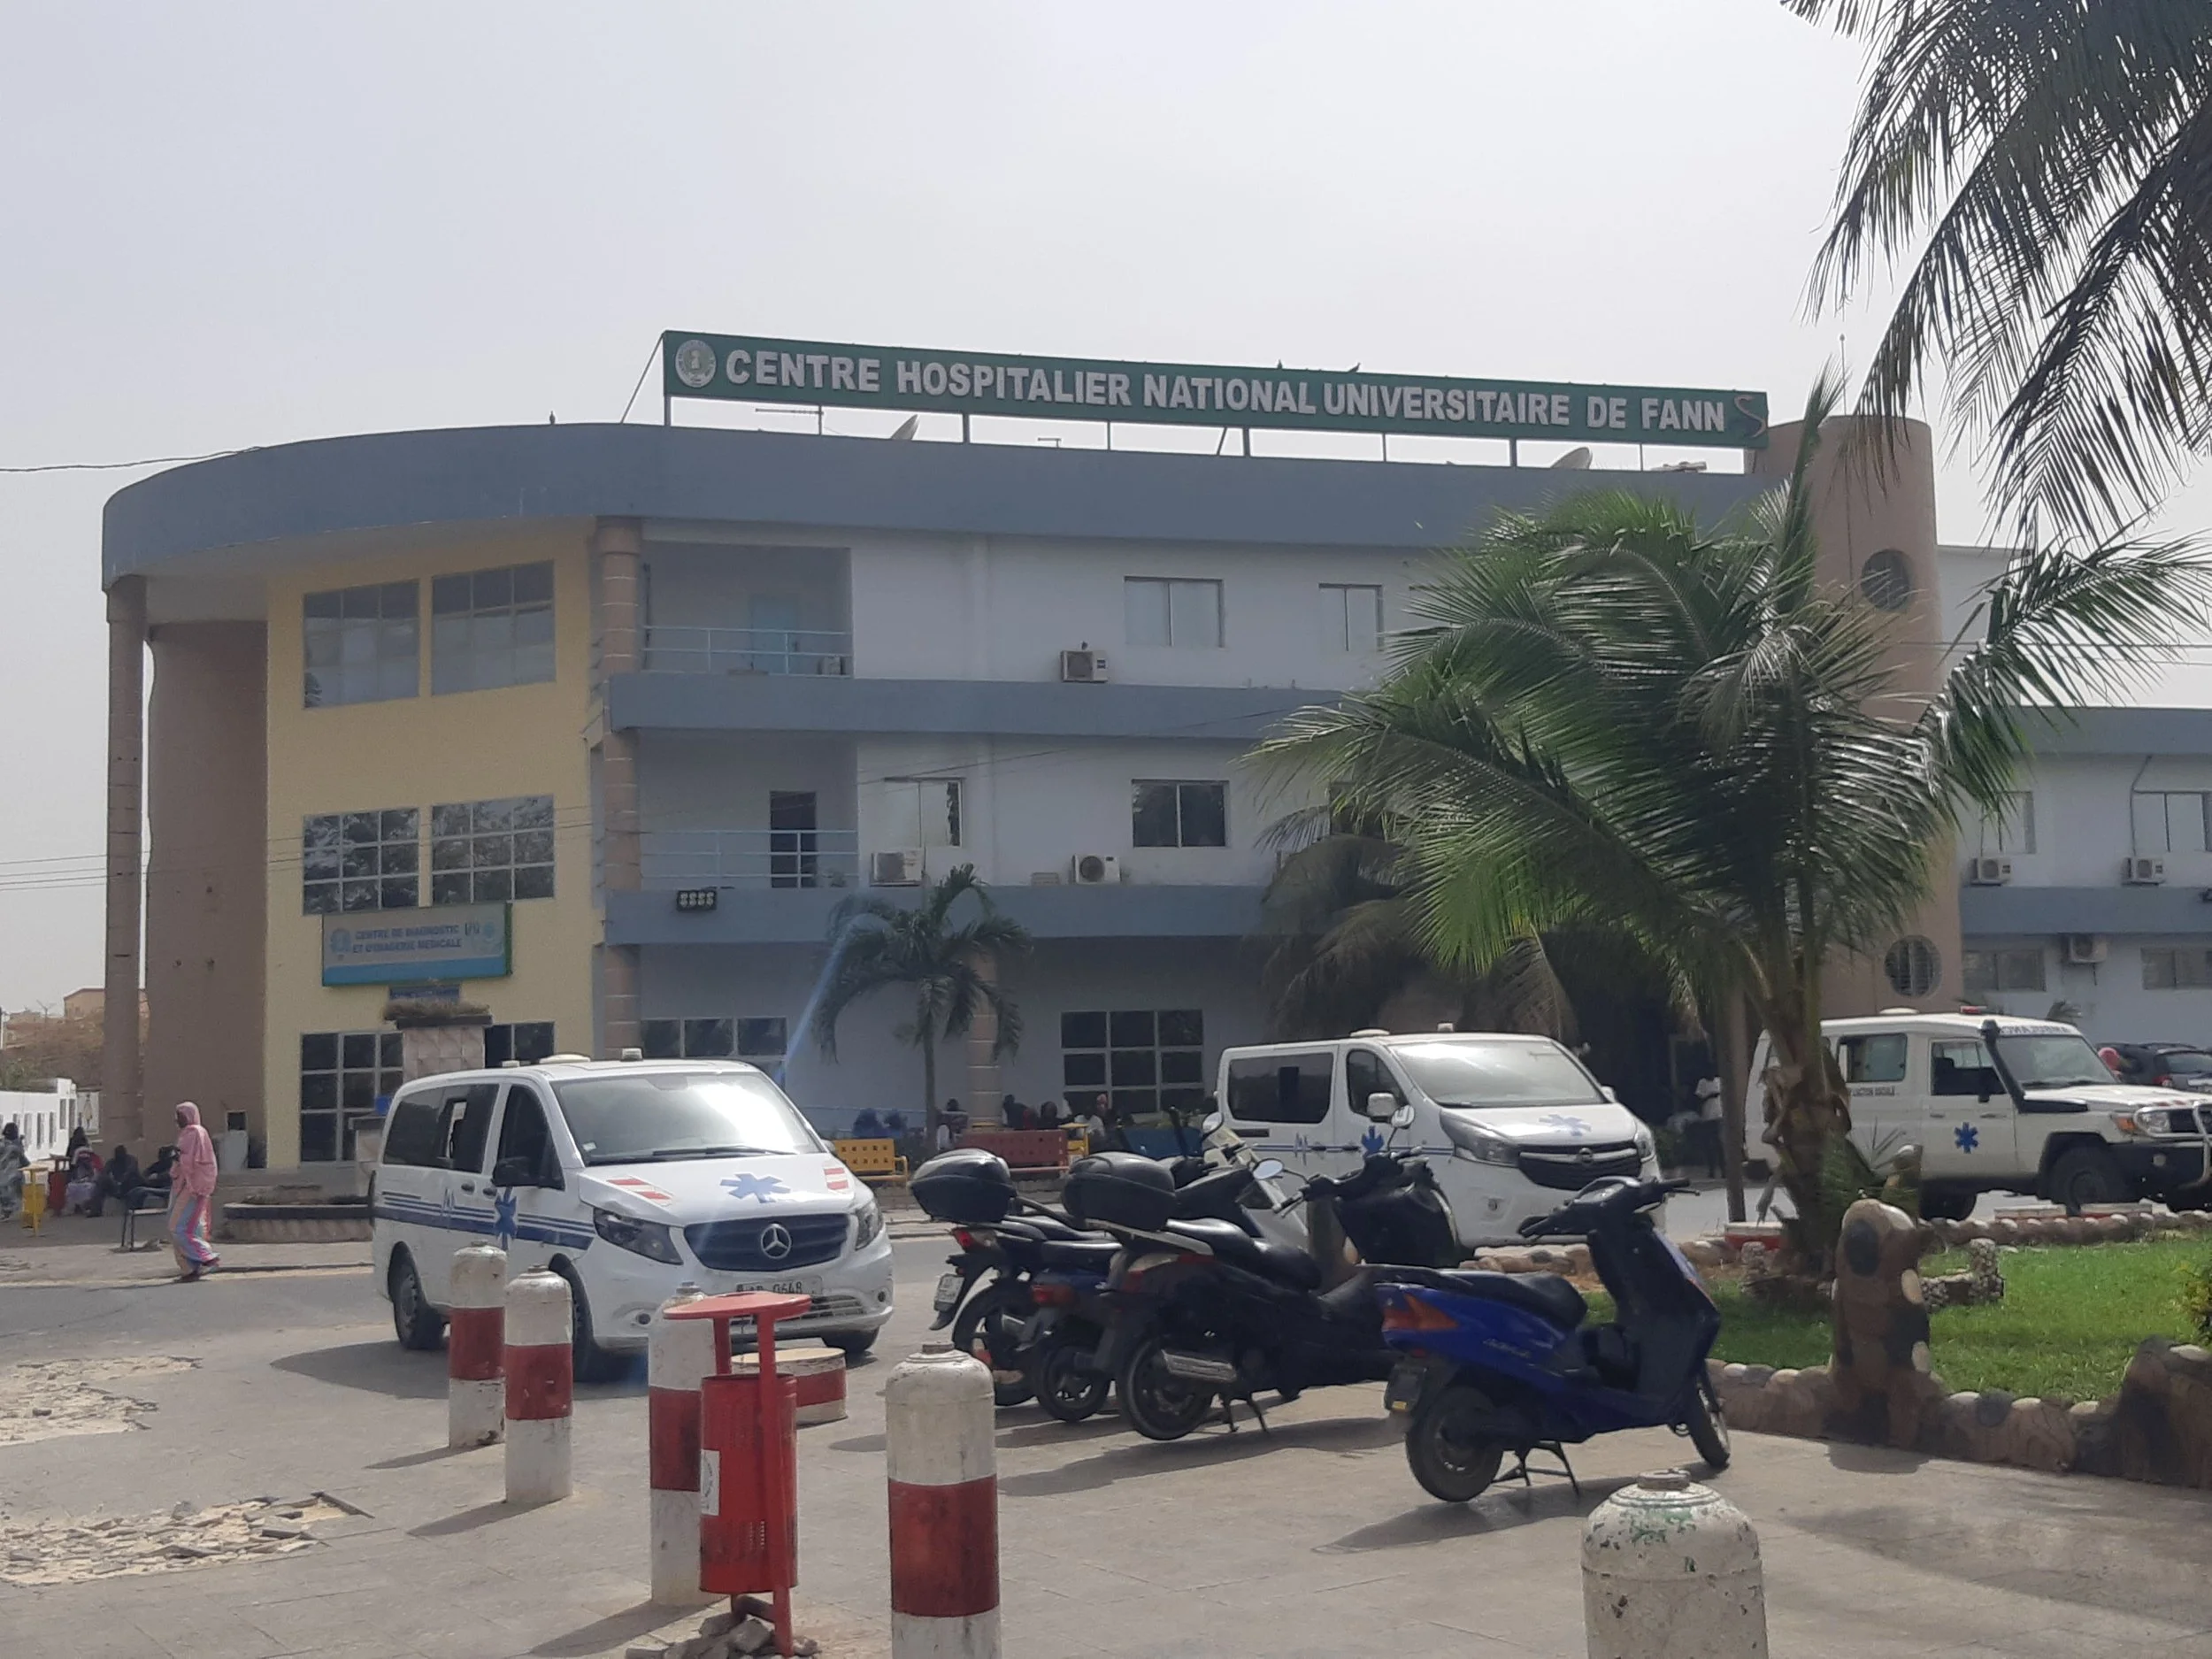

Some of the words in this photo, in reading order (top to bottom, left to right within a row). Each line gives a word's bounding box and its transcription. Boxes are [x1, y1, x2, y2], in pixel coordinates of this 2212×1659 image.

[726, 349, 880, 392] CENTRE
[896, 360, 1132, 406] HOSPITALIER
[1143, 373, 1317, 415] NATIONAL
[1323, 382, 1571, 425] UNIVERSITAIRE
[1586, 396, 1627, 429] DE
[1641, 397, 1724, 432] FANN
[356, 929, 388, 940] CENTRE
[392, 927, 403, 937] DE
